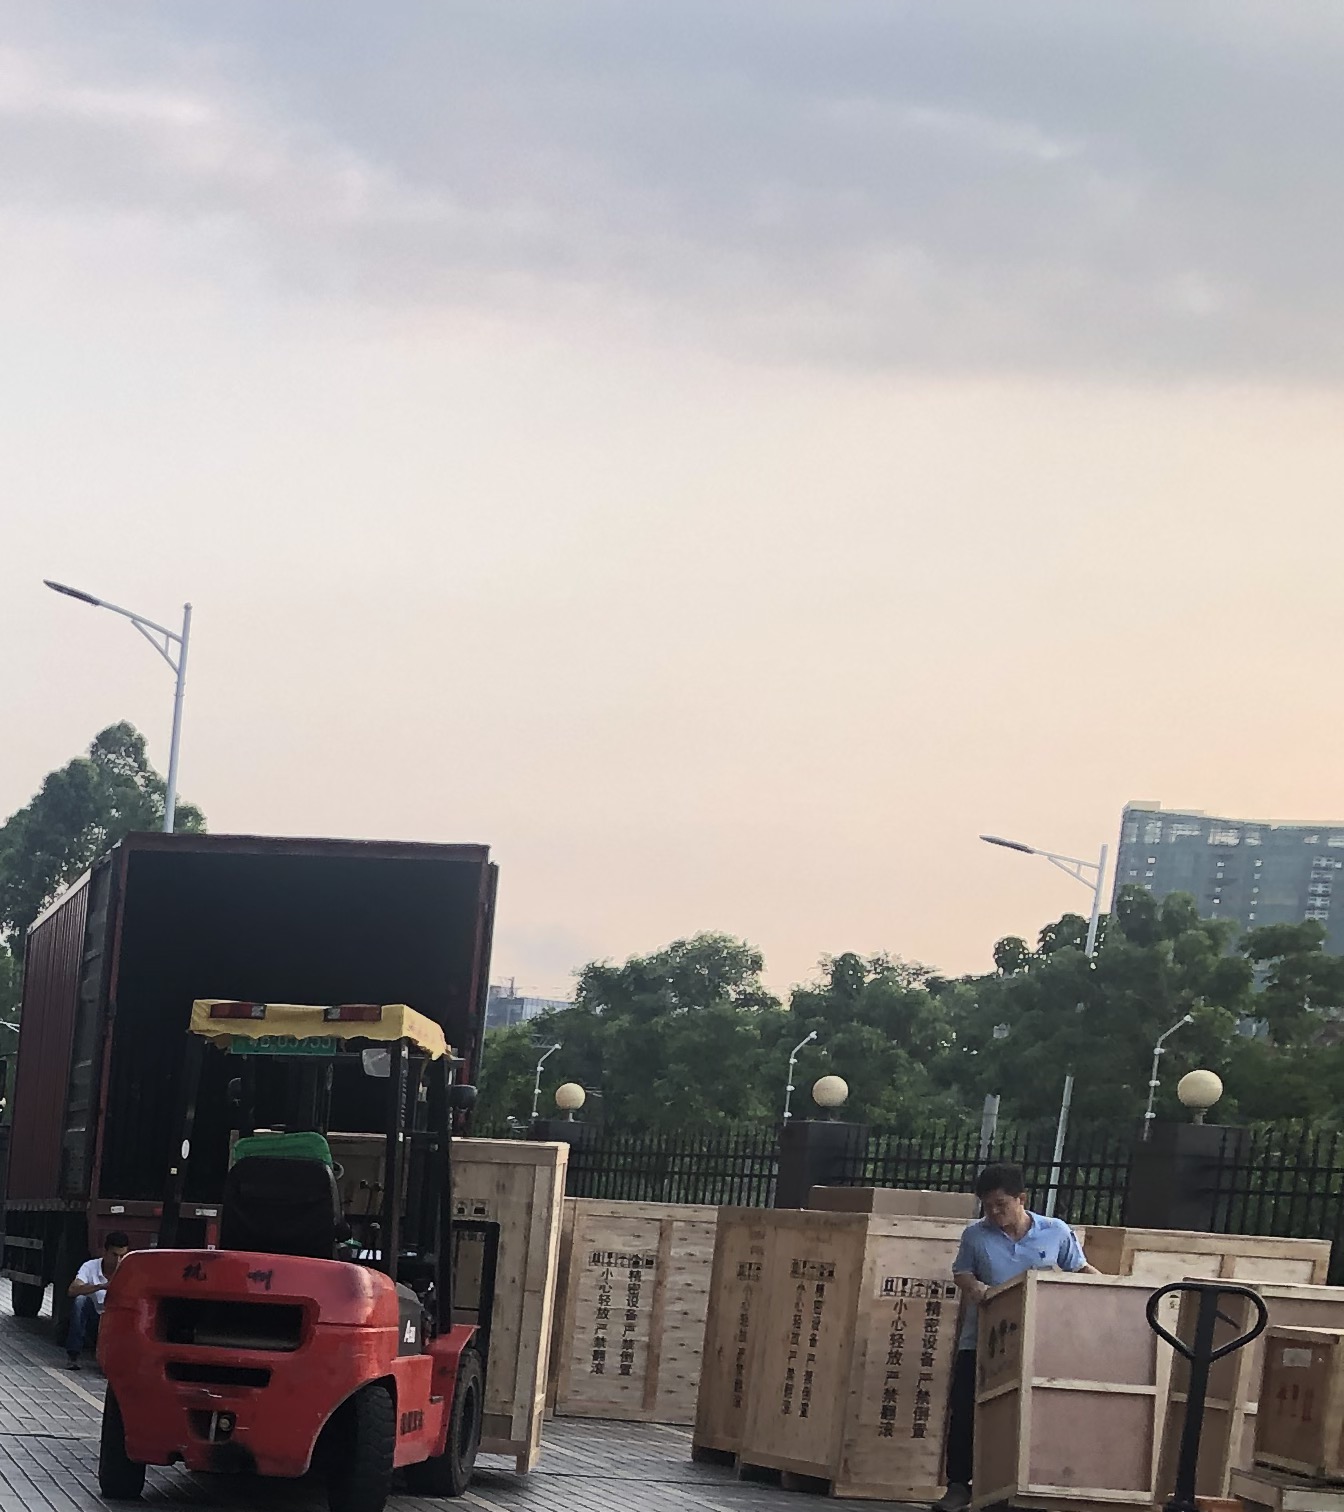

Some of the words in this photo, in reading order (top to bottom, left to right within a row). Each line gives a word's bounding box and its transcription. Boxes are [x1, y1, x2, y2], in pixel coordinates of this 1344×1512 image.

[596, 1268, 613, 1320] 小心轻放
[886, 1299, 908, 1366] 小心轻放
[920, 1301, 941, 1367] 精密设备
